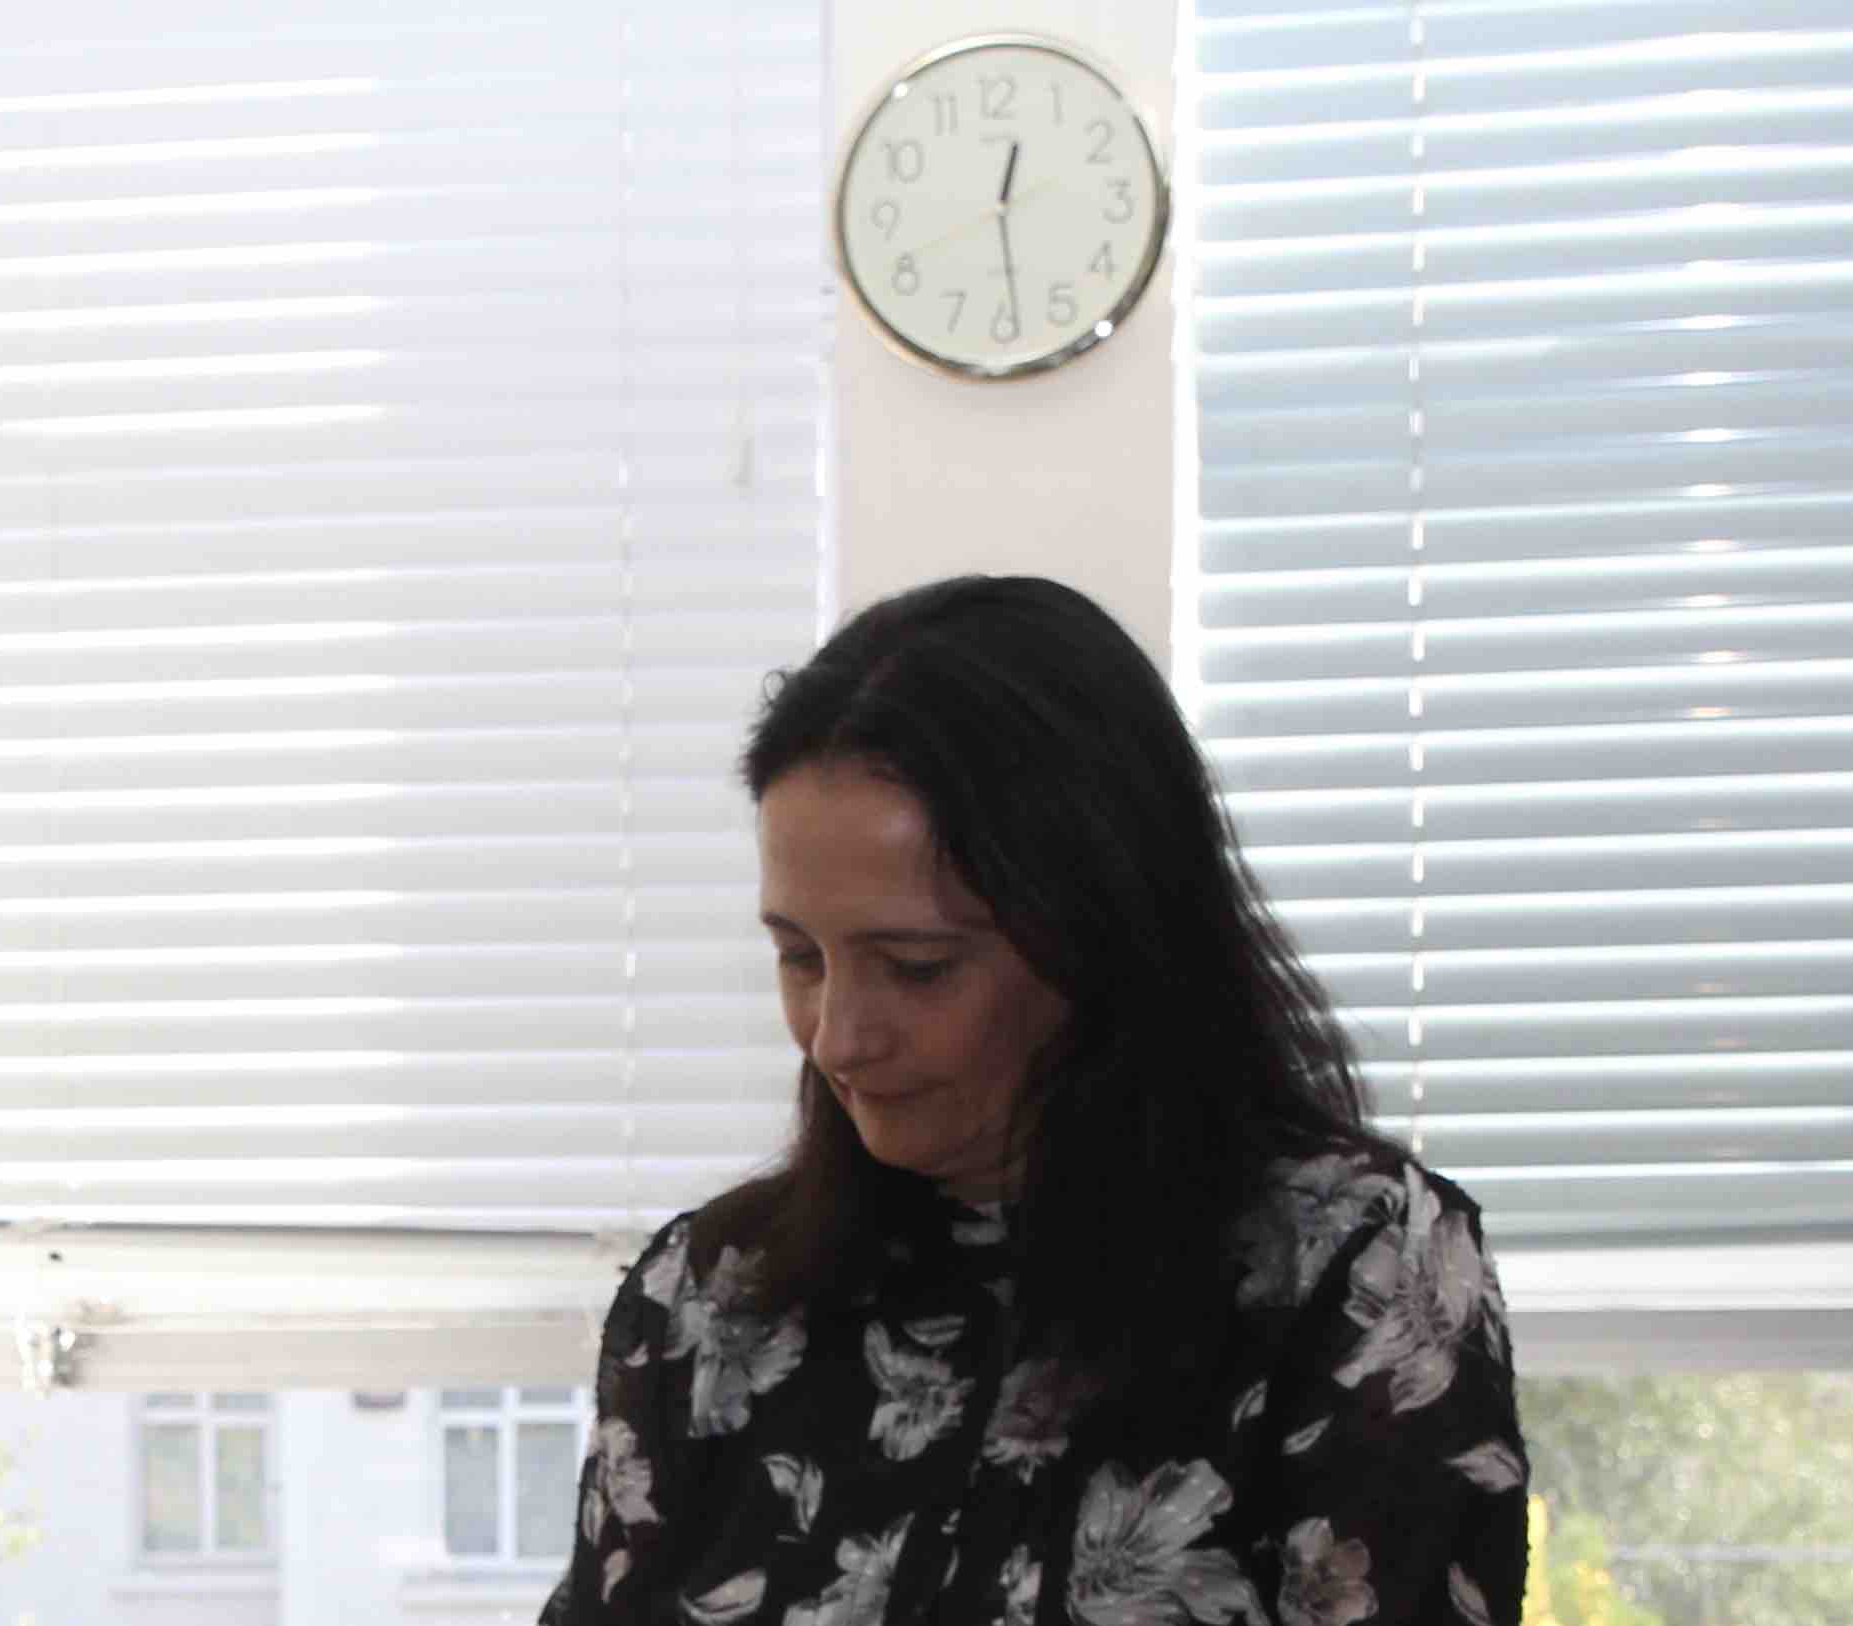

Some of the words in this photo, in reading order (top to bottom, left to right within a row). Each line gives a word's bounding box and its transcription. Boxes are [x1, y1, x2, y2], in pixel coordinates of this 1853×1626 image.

[932, 95, 959, 136] 11
[978, 75, 1016, 120] 12
[1050, 82, 1064, 124] 1
[883, 139, 924, 183] 10
[1085, 120, 1115, 165] 2
[870, 200, 900, 241] 9
[1103, 178, 1134, 224] 3
[891, 253, 919, 296] 8
[1088, 240, 1116, 280] 4
[940, 291, 967, 334] 7
[990, 303, 1020, 344] 6
[1048, 282, 1076, 326] 5
